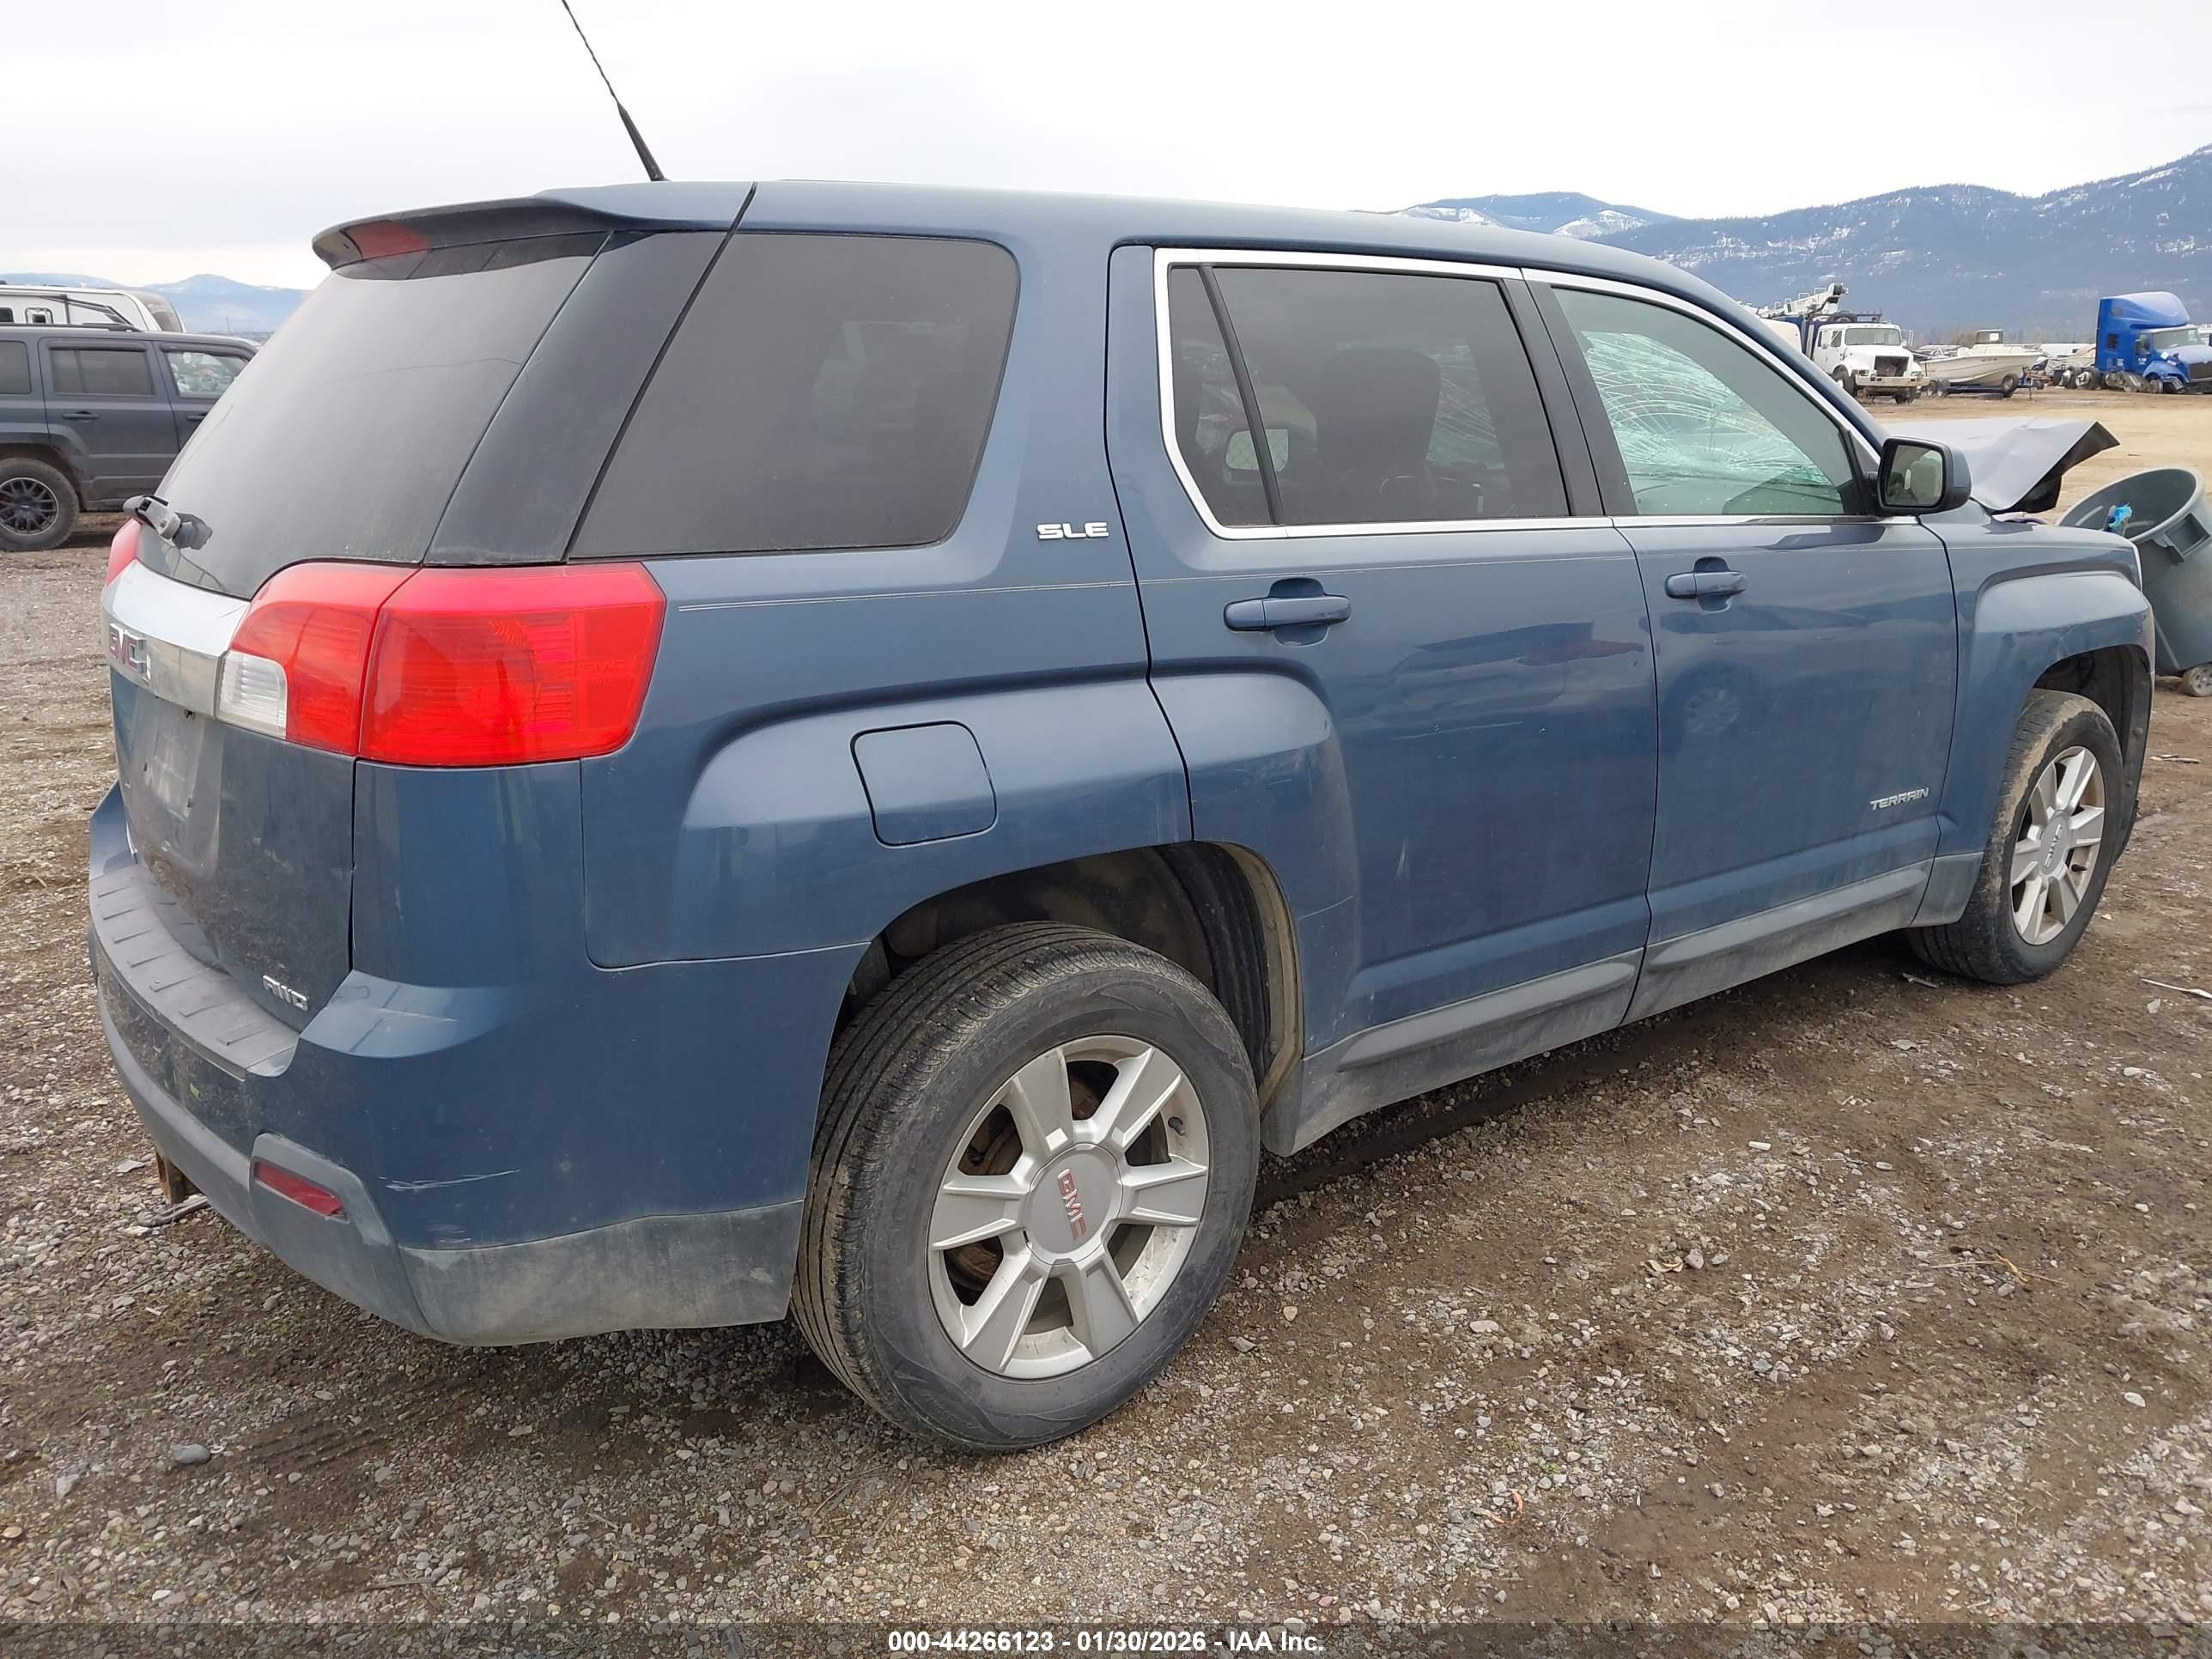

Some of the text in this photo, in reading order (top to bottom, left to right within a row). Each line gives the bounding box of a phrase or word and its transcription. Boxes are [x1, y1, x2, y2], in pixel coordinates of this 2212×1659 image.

[1036, 521, 1109, 540] SLE
[109, 623, 150, 682] GMC
[1869, 787, 1929, 811] TERRAIN
[262, 975, 308, 1012] AWD
[1057, 1168, 1086, 1241] GMC
